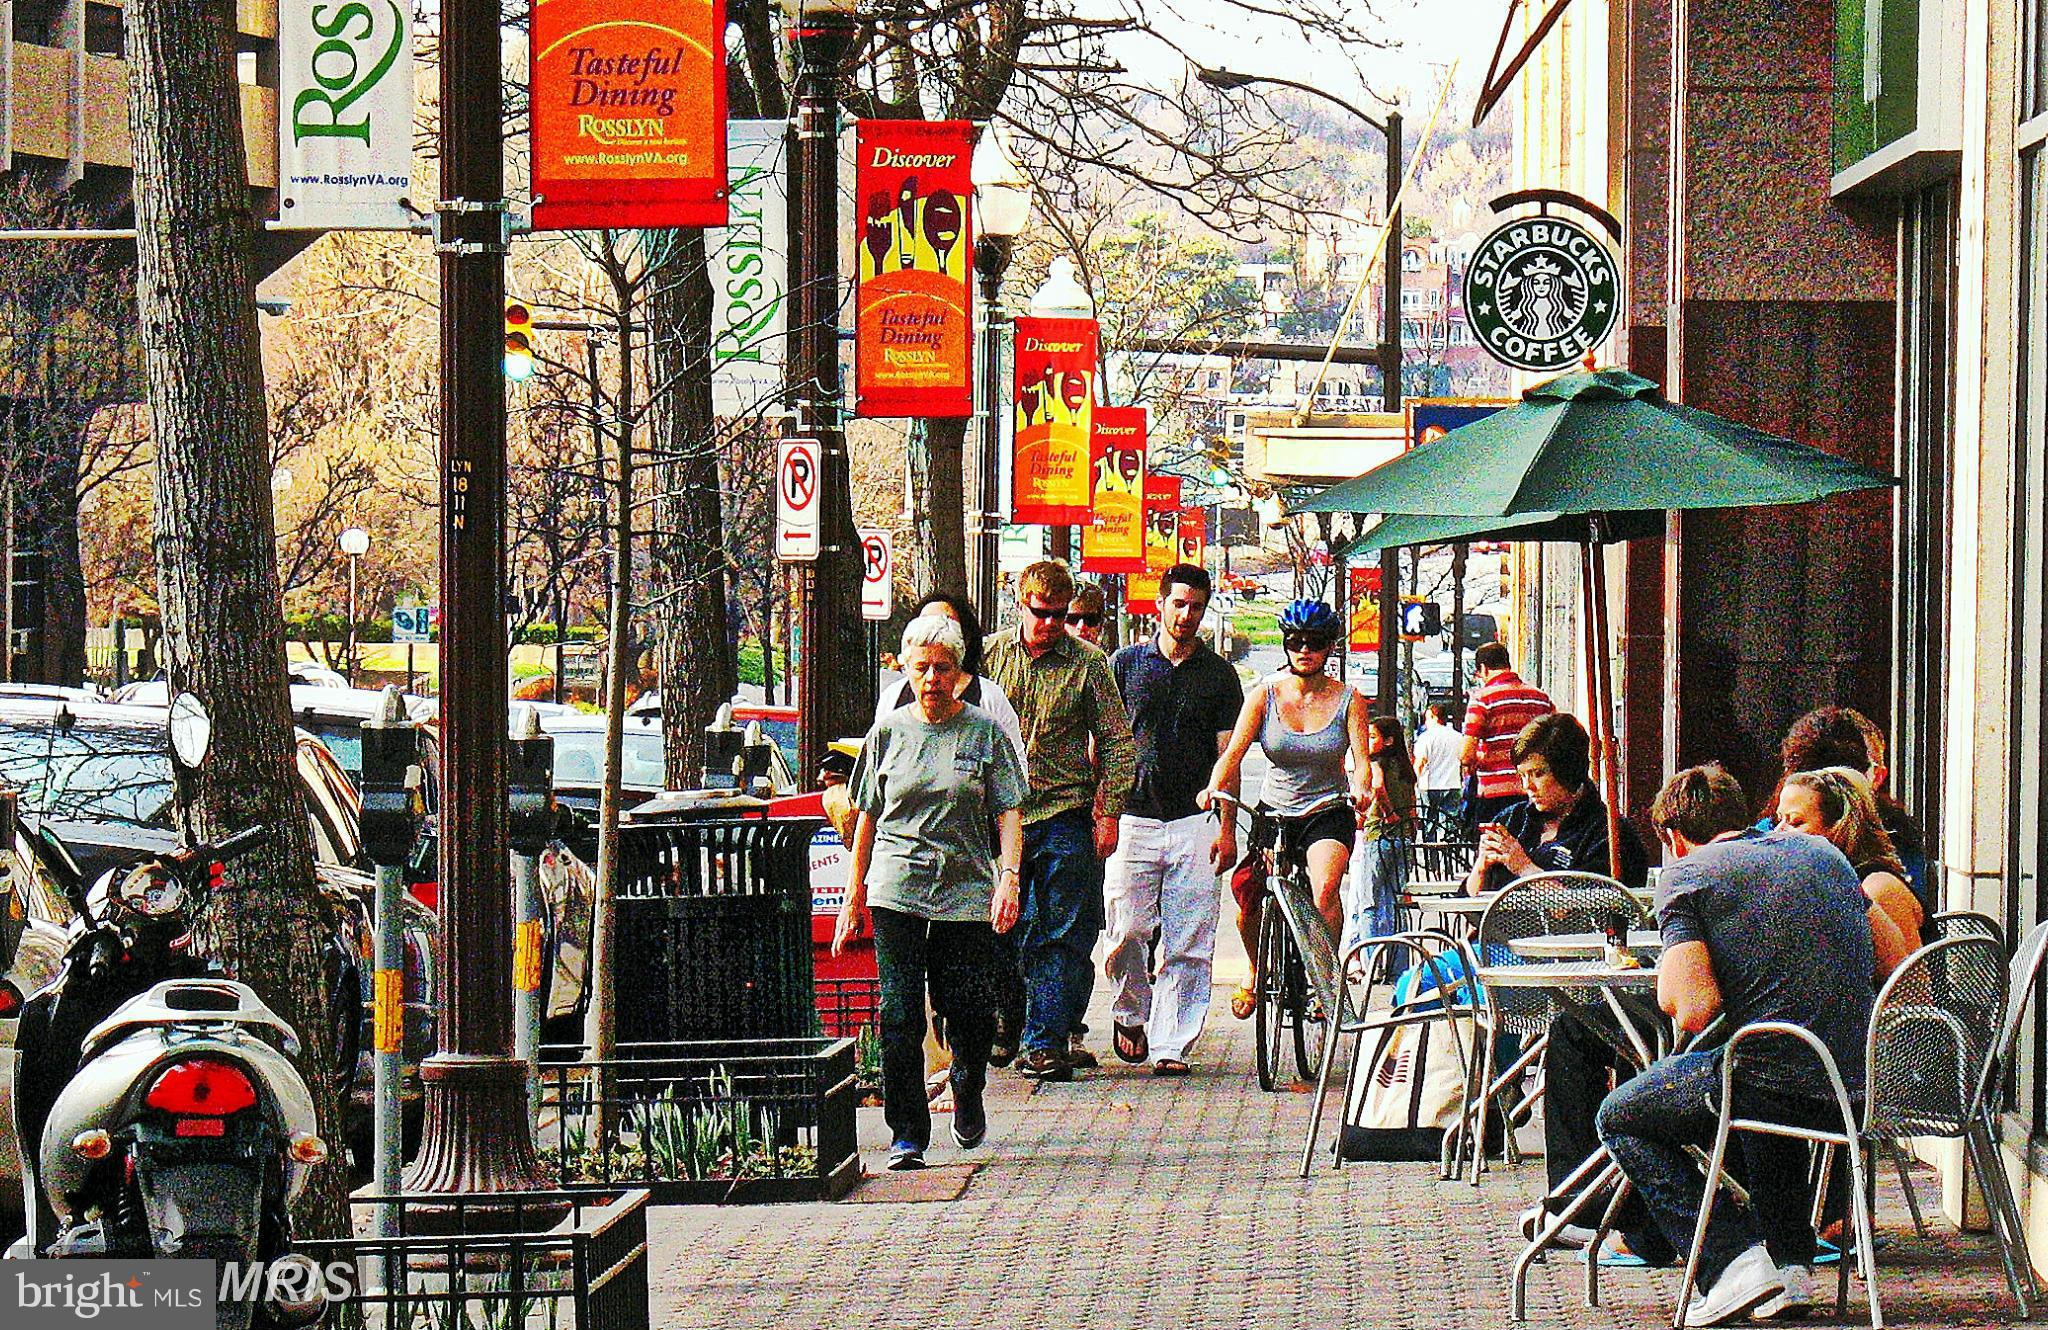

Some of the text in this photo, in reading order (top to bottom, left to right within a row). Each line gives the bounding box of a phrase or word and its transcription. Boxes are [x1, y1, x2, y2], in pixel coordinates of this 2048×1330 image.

[569, 47, 685, 86] Tasteful
[569, 78, 677, 116] Dining
[577, 113, 665, 143] ROSSLYN
[563, 153, 688, 167] www.RosslynVA.org
[871, 146, 956, 168] Discover
[290, 174, 408, 188] www.RosslynVA.org
[1474, 223, 1610, 288] STARBUCKS
[879, 308, 948, 333] Tasteful
[879, 327, 945, 350] Dining
[1025, 337, 1085, 353] Discover
[1490, 325, 1594, 363] COFFEE
[451, 460, 472, 472] LYN
[1030, 462, 1074, 479] Dining
[453, 476, 468, 492] 18
[454, 495, 465, 510] 11
[453, 514, 465, 530] N
